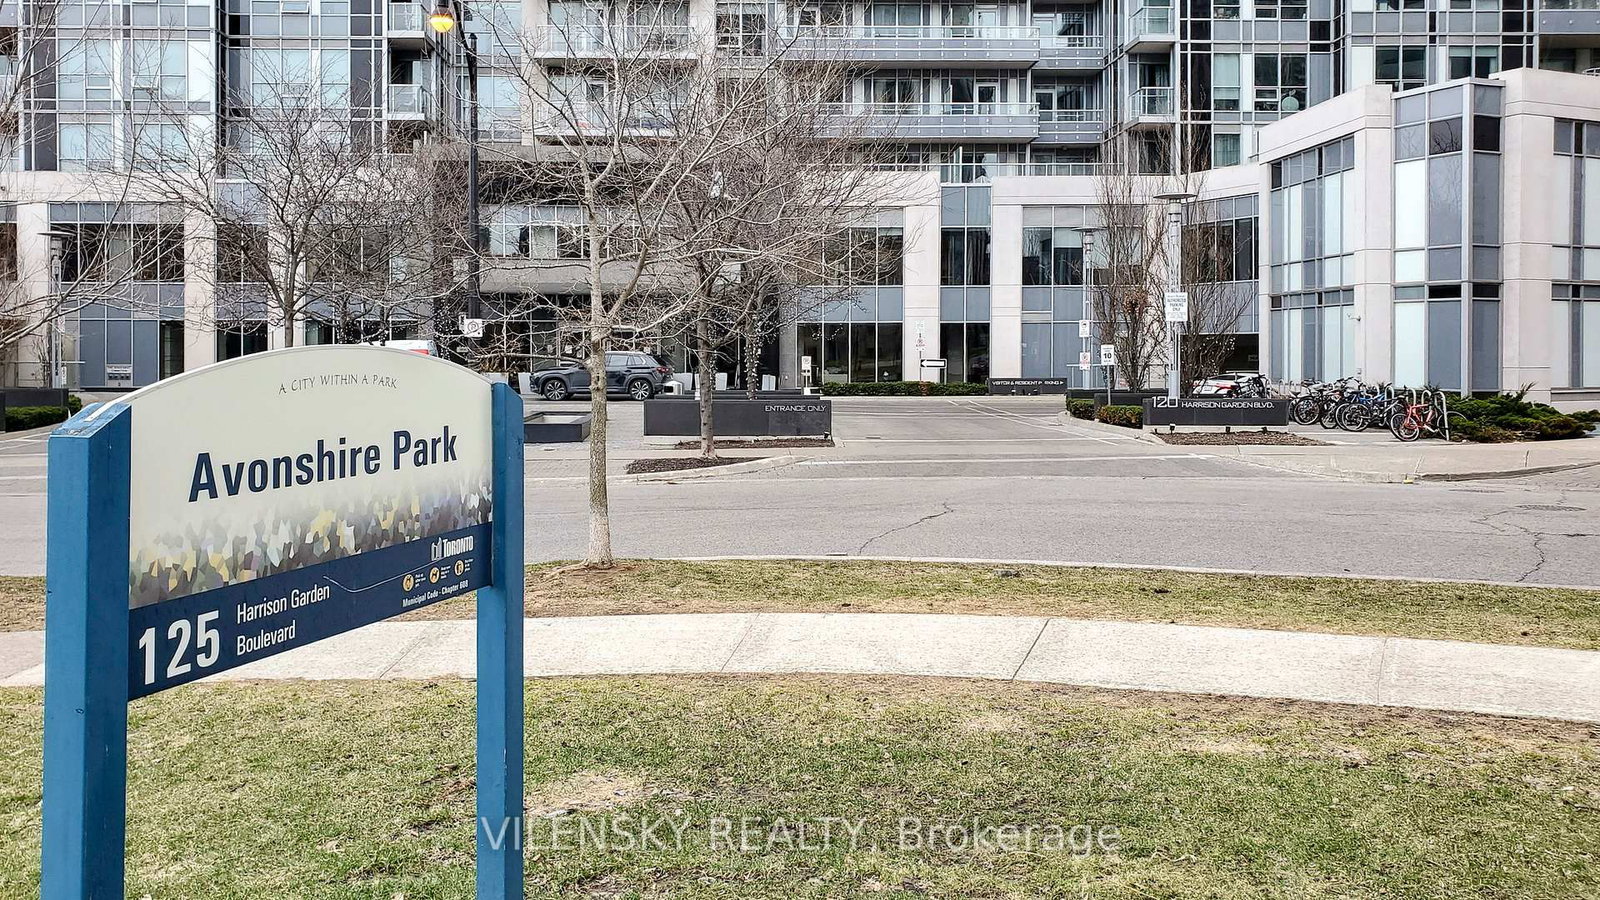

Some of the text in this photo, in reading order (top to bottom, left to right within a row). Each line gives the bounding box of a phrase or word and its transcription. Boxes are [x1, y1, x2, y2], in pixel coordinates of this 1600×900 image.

[279, 374, 397, 395] A CITY WITHIN A PARK
[1151, 396, 1275, 409] 120 HARRISON GARDEN BLVD.
[188, 425, 457, 502] Avonshire Park
[443, 536, 473, 557] TORONTO
[236, 585, 330, 624] Harrison Garden
[403, 593, 426, 607] Municipal
[427, 590, 438, 600] Code
[442, 584, 459, 595] Chapter
[460, 580, 468, 589] 608
[138, 610, 220, 685] 125
[236, 620, 296, 656] Boulevard
